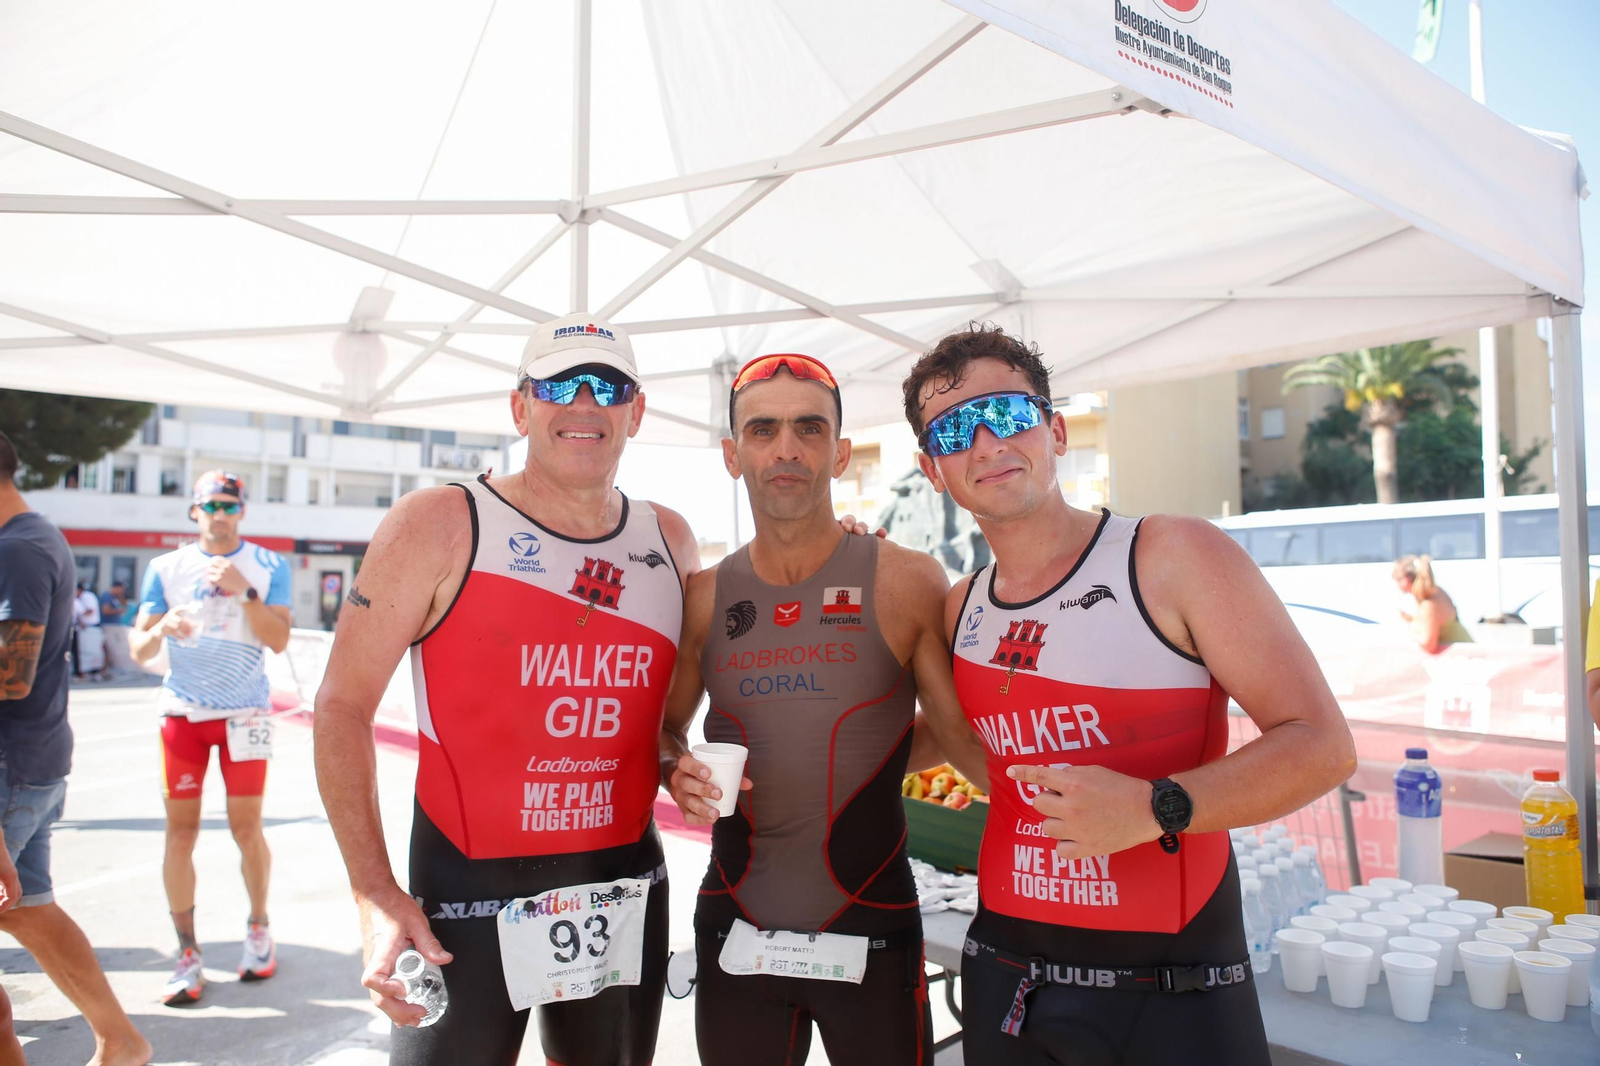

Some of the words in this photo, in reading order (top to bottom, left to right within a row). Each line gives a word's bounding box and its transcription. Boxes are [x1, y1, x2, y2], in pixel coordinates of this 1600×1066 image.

[1115, 0, 1171, 45] Delegación
[1173, 29, 1185, 52] de
[1187, 35, 1231, 75] Deportes
[1115, 26, 1141, 51] Ilustre
[1142, 39, 1191, 73] Ayuntamiento
[1192, 63, 1200, 77] de
[1201, 67, 1213, 84] San
[1214, 73, 1232, 95] Roque
[554, 324, 613, 337] IRONMAN
[508, 564, 546, 573] Triathlon
[514, 558, 540, 566] World
[628, 552, 662, 564] kiwami
[1059, 590, 1105, 611] kiwami
[819, 614, 861, 625] Hercules
[520, 644, 653, 688] WALKER
[715, 642, 857, 673] LADBROKES
[739, 673, 825, 697] CORAL
[545, 696, 621, 738] GIB
[973, 703, 1110, 757] WALKER
[248, 728, 271, 745] 52
[526, 756, 620, 773] Ladbrokes
[523, 782, 560, 809] WE
[564, 780, 614, 807] PLAY
[520, 804, 613, 832] TOGETHER
[1014, 844, 1045, 876] WE
[1051, 849, 1110, 880] PLAY
[1012, 871, 1119, 906] TOGETHER
[430, 899, 501, 919] XLAB
[548, 914, 611, 963] 93
